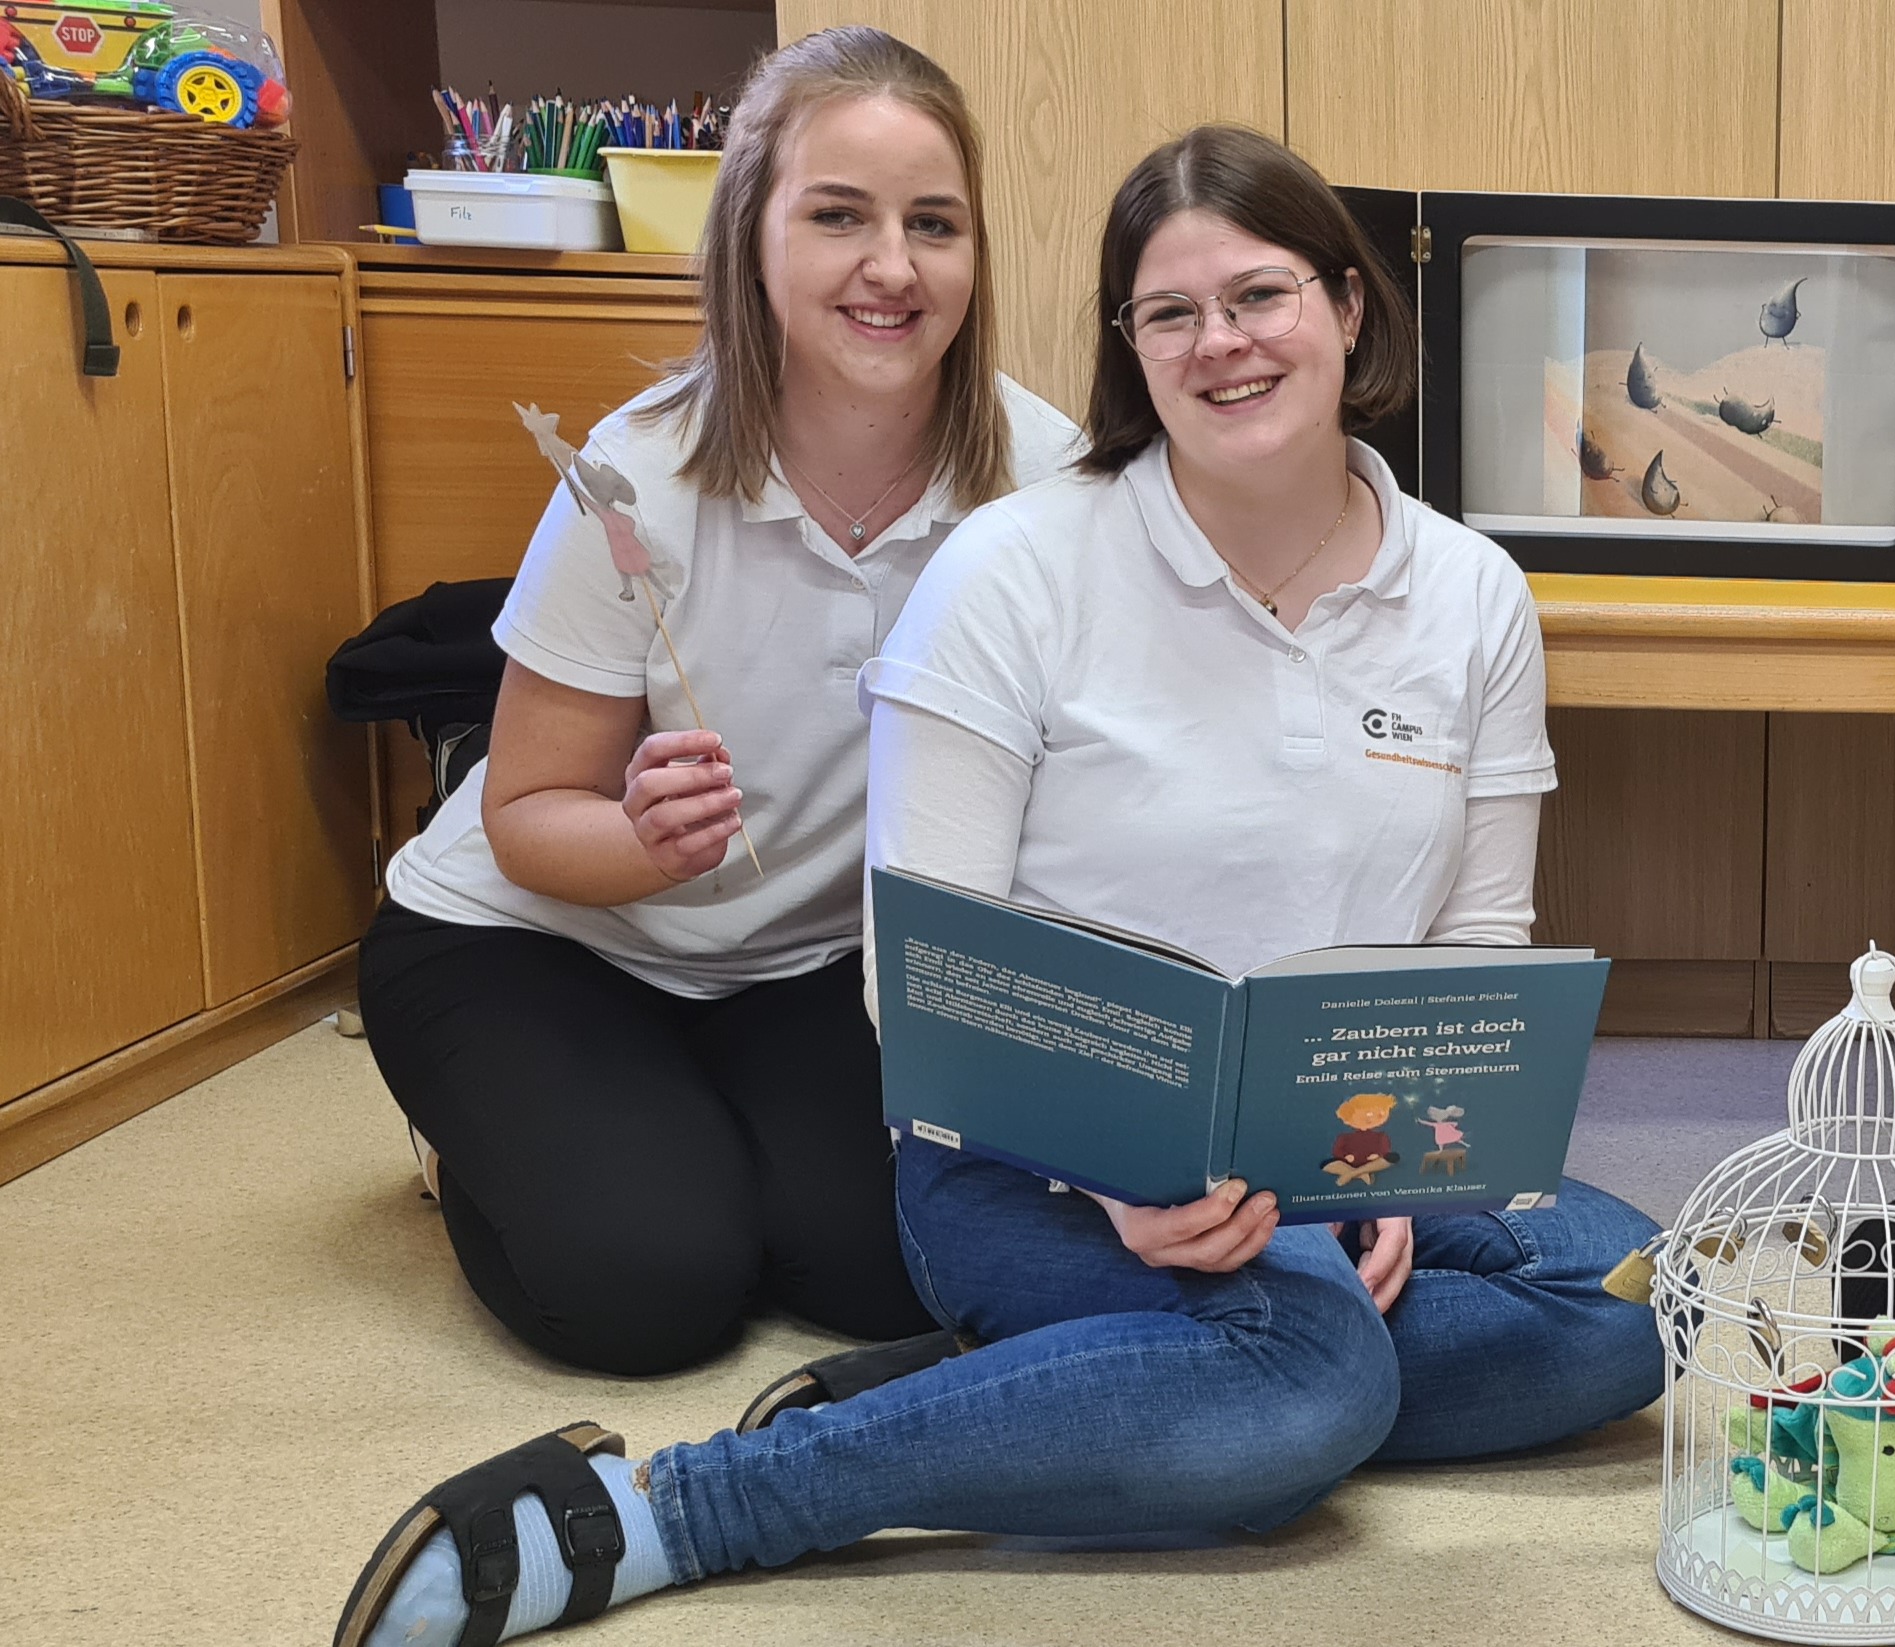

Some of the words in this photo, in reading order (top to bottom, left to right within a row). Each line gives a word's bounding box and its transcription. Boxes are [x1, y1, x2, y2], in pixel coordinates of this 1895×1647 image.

[60, 26, 95, 43] STOP
[1391, 712, 1402, 722] FH
[1391, 722, 1423, 736] CAMPUS
[1392, 731, 1413, 743] WIEN
[1321, 999, 1370, 1009] Danielle
[1374, 996, 1418, 1006] Dolezal
[1428, 994, 1475, 1004] Stefanie
[1479, 992, 1519, 1002] Pichler
[1331, 1024, 1428, 1041] Zaubern
[1436, 1022, 1464, 1036] ist
[1471, 1018, 1526, 1033] doch
[1311, 1051, 1350, 1066] gar
[1358, 1045, 1416, 1061] nicht
[1422, 1040, 1511, 1058] schwer!
[1296, 1071, 1338, 1084] Emils
[1342, 1070, 1382, 1081] Reise
[1387, 1068, 1420, 1078] zum
[1425, 1062, 1520, 1076] Sternenturm
[1292, 1191, 1366, 1203] Illustrationen
[1394, 1186, 1442, 1196] Veronika
